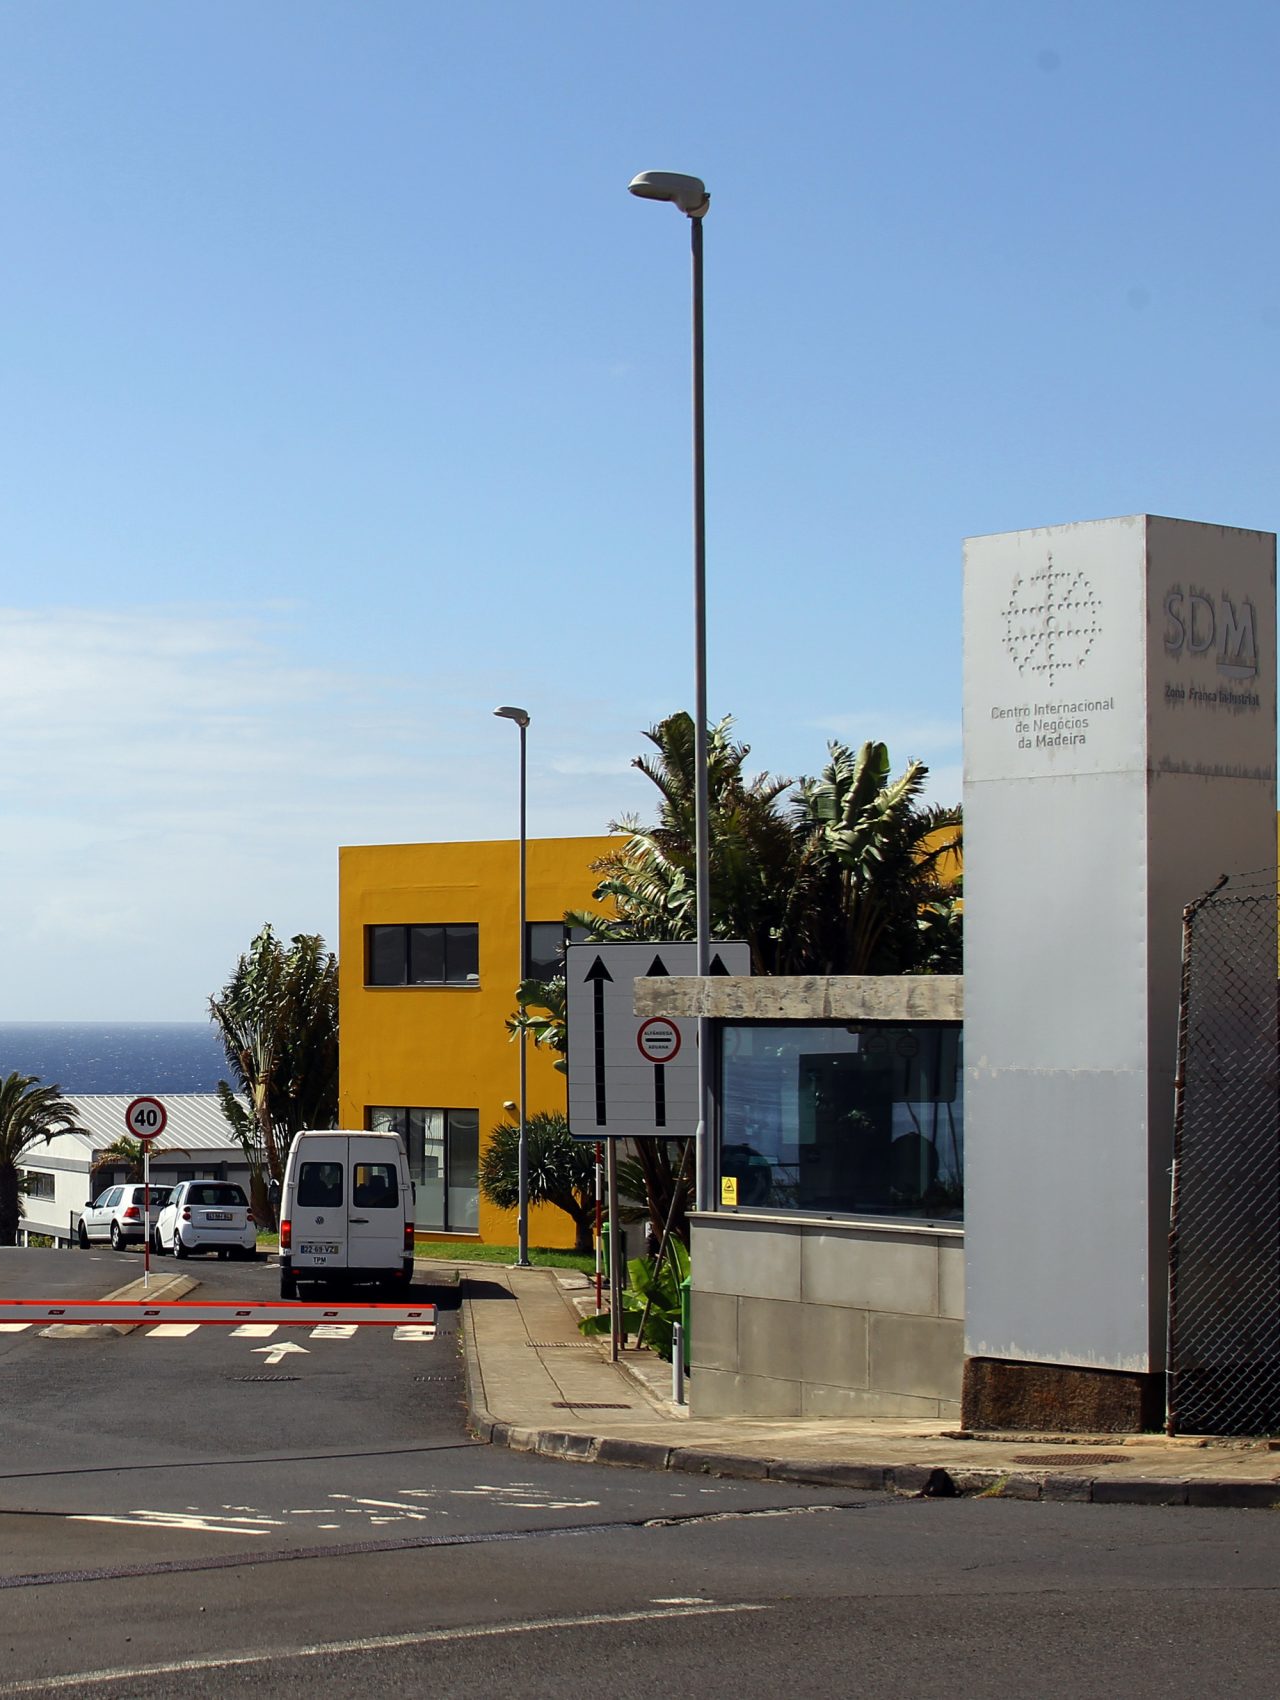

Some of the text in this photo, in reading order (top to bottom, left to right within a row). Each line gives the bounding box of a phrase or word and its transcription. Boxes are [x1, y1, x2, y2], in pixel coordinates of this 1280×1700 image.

[1165, 592, 1257, 659] SDM
[1165, 685, 1260, 706] Zona Franca Industrial
[991, 697, 1114, 720] Centro Internacional
[1015, 717, 1089, 734] de Negócios
[1018, 732, 1086, 749] da Madeira
[135, 1109, 157, 1126] 40
